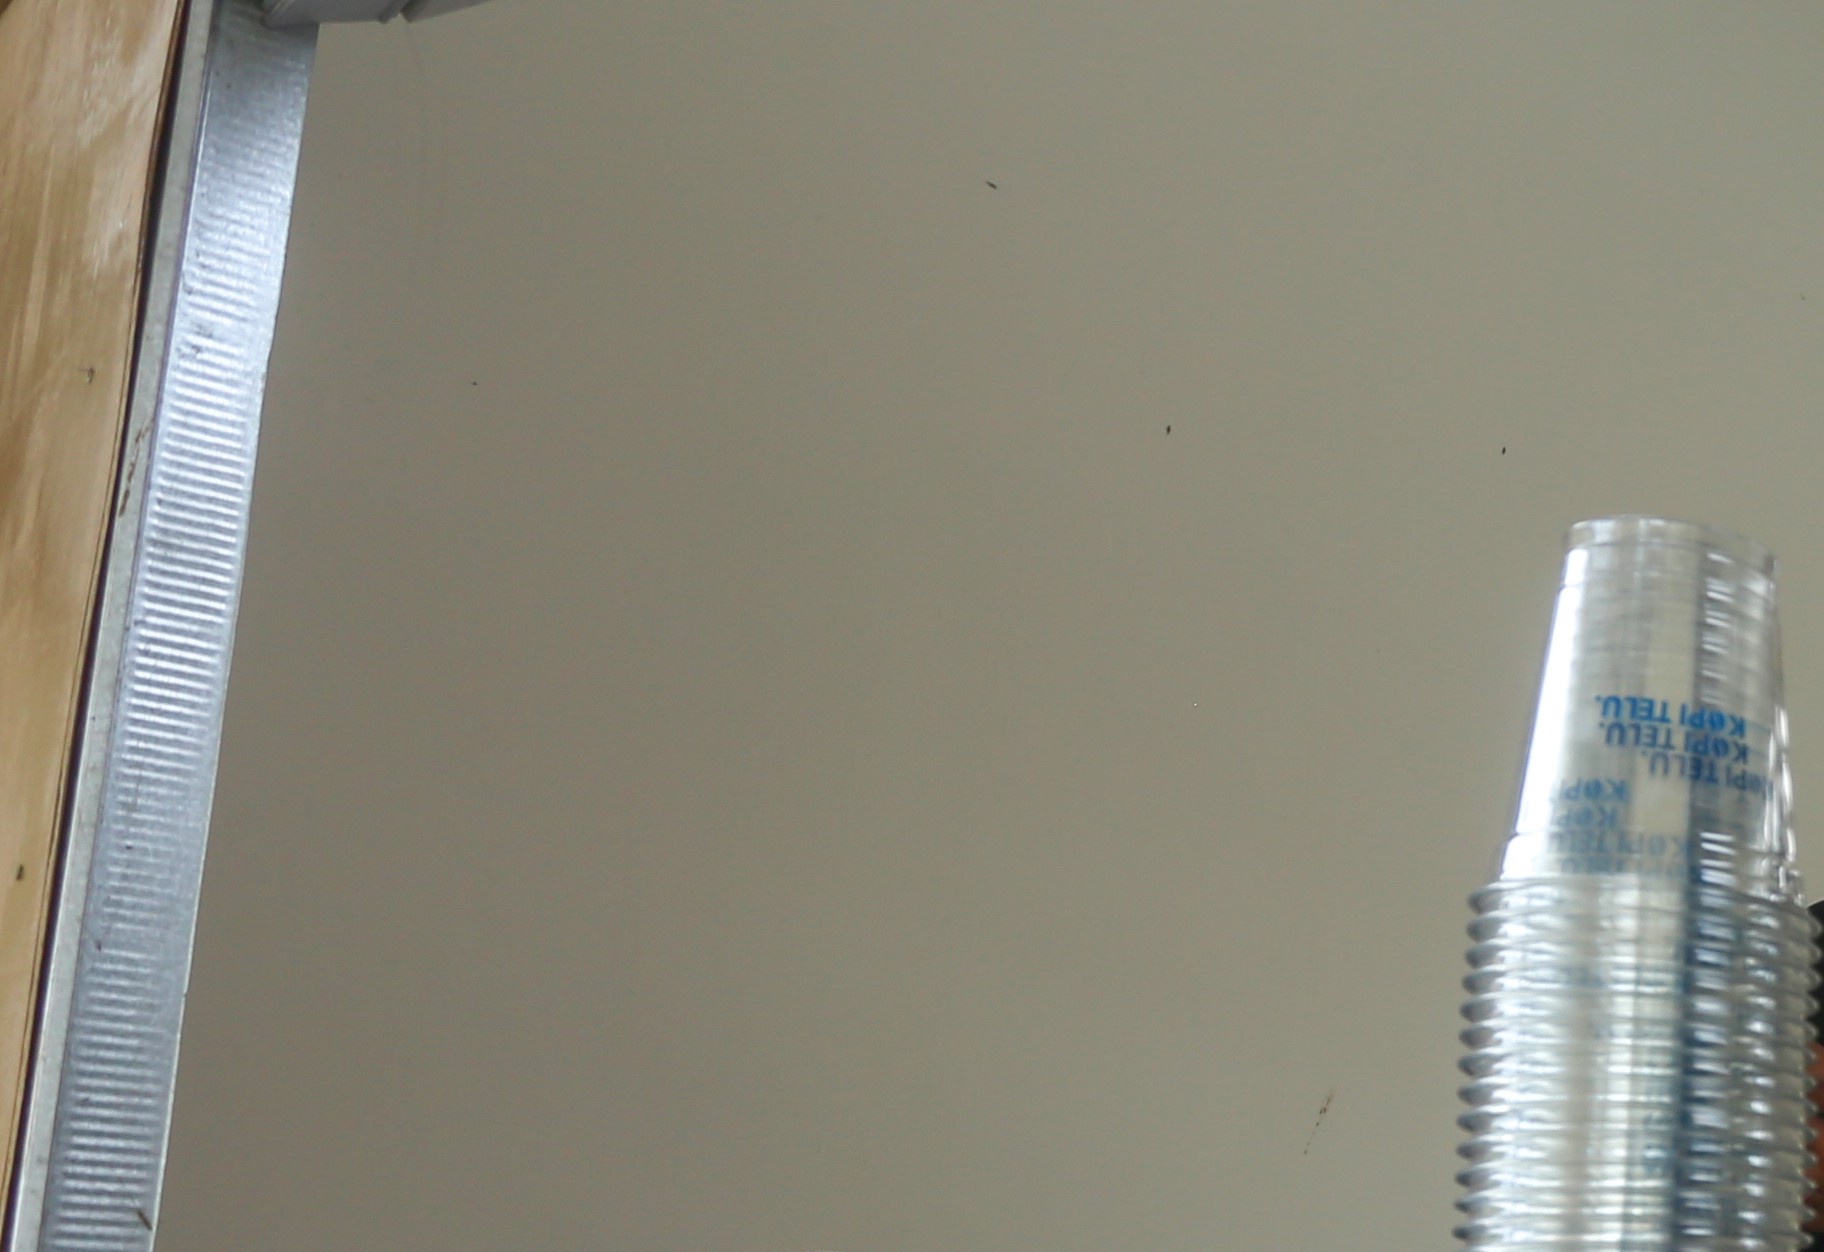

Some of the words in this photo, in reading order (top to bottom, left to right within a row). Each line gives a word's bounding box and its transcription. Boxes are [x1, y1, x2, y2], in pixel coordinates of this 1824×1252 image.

[1596, 696, 1670, 724] TELU.
[1679, 703, 1745, 738] KOPI
[1600, 722, 1675, 751] TELU.
[1684, 731, 1749, 763] KOPI
